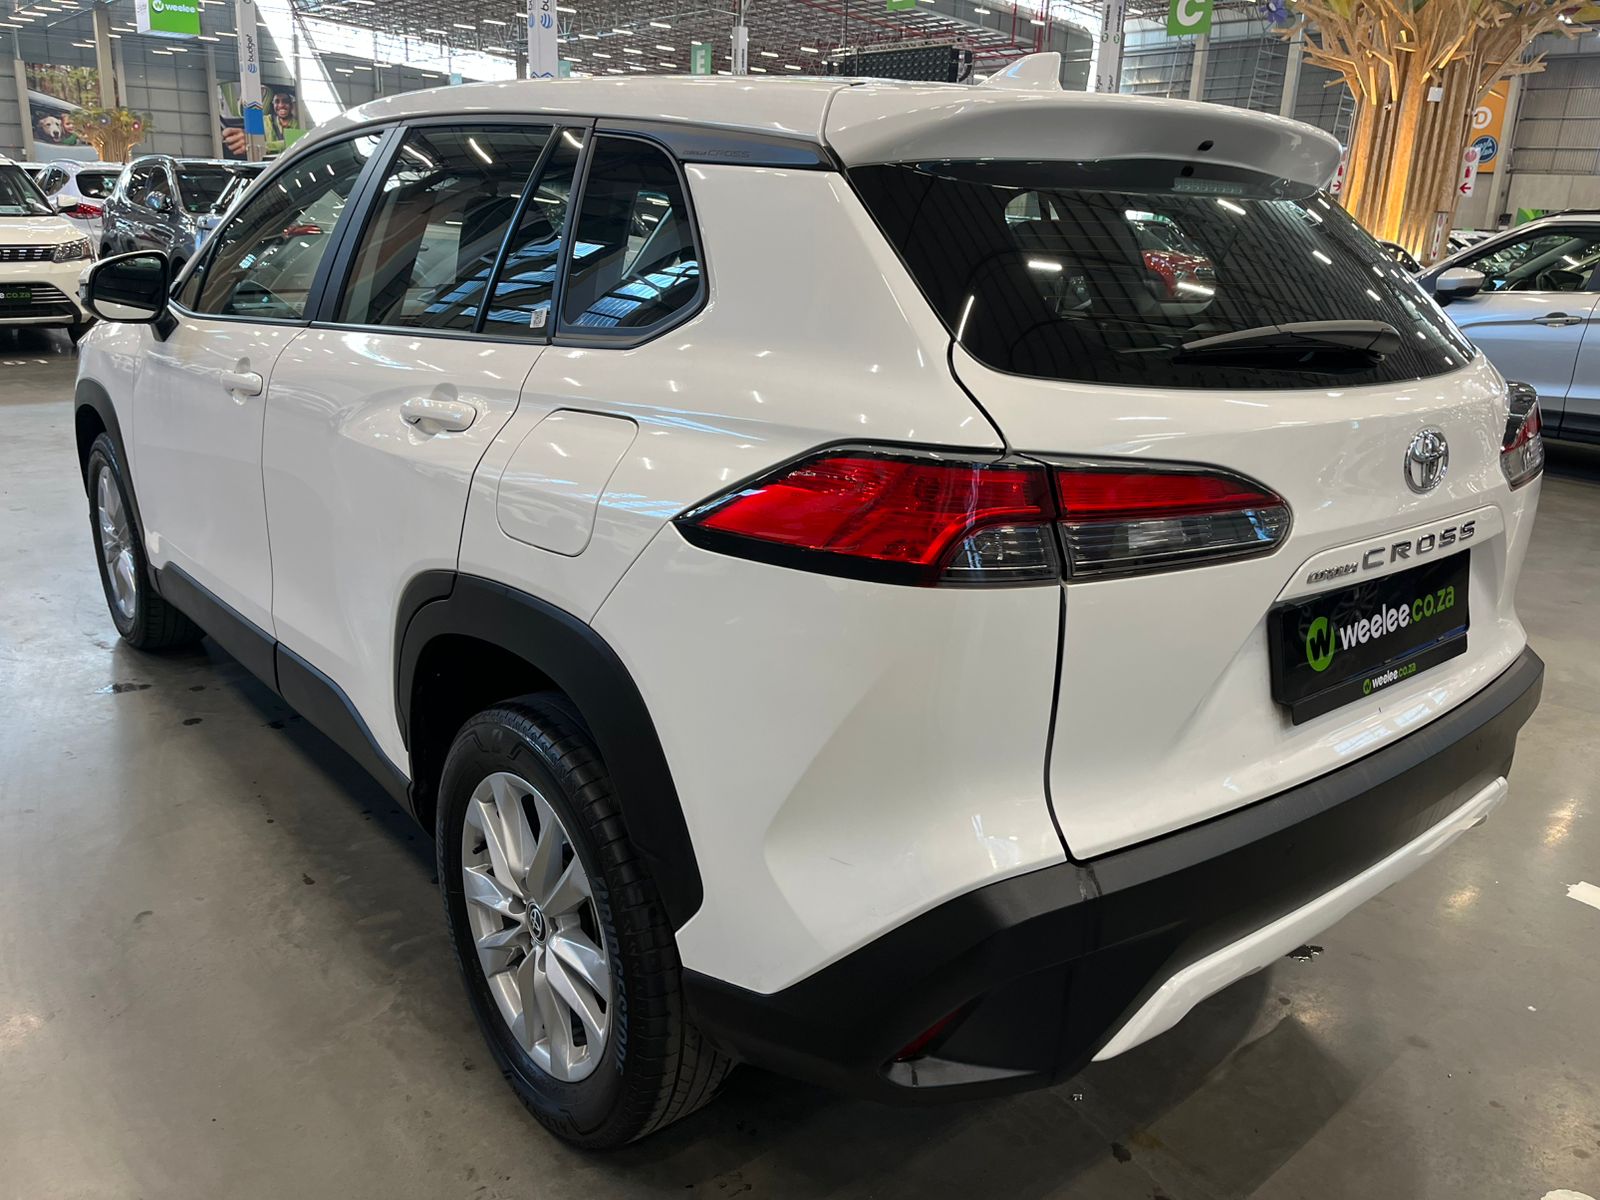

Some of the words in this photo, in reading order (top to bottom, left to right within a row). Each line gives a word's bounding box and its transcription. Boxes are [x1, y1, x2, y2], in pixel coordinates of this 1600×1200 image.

[1177, 0, 1206, 26] C
[1362, 520, 1476, 570] CROSS
[1340, 586, 1455, 650] weelee.co.za
